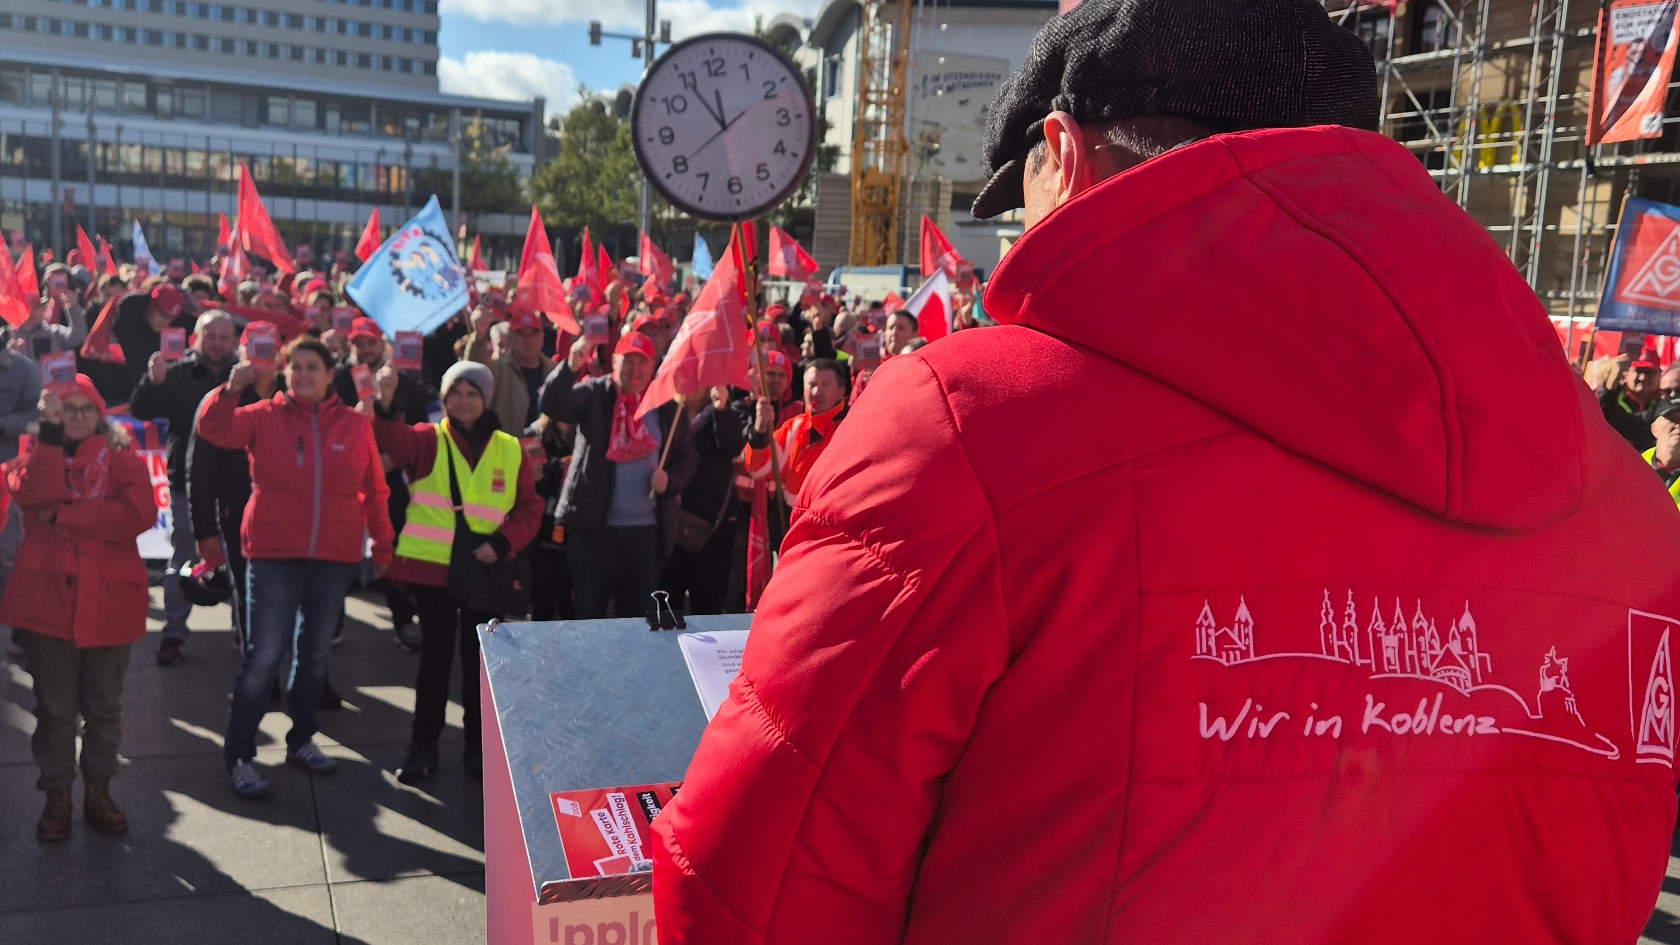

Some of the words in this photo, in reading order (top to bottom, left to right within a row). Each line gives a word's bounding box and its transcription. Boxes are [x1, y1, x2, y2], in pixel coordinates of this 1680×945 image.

[702, 57, 727, 78] 12
[740, 63, 750, 81] 1
[678, 71, 697, 90] 11
[762, 80, 778, 99] 2
[660, 94, 687, 115] 10
[776, 107, 791, 126] 3
[658, 126, 674, 145] 9
[773, 139, 787, 157] 4
[672, 155, 689, 174] 8
[756, 163, 770, 181] 5
[697, 172, 709, 191] 7
[727, 176, 743, 194] 6
[1199, 698, 1290, 741] Wir
[1303, 703, 1342, 740] in
[1362, 692, 1500, 737] Koblenz
[570, 802, 580, 815] DGB
[597, 811, 616, 835] Karte
[611, 795, 637, 845] Kahlschlag!
[611, 836, 627, 856] Rote
[630, 845, 641, 861] dem
